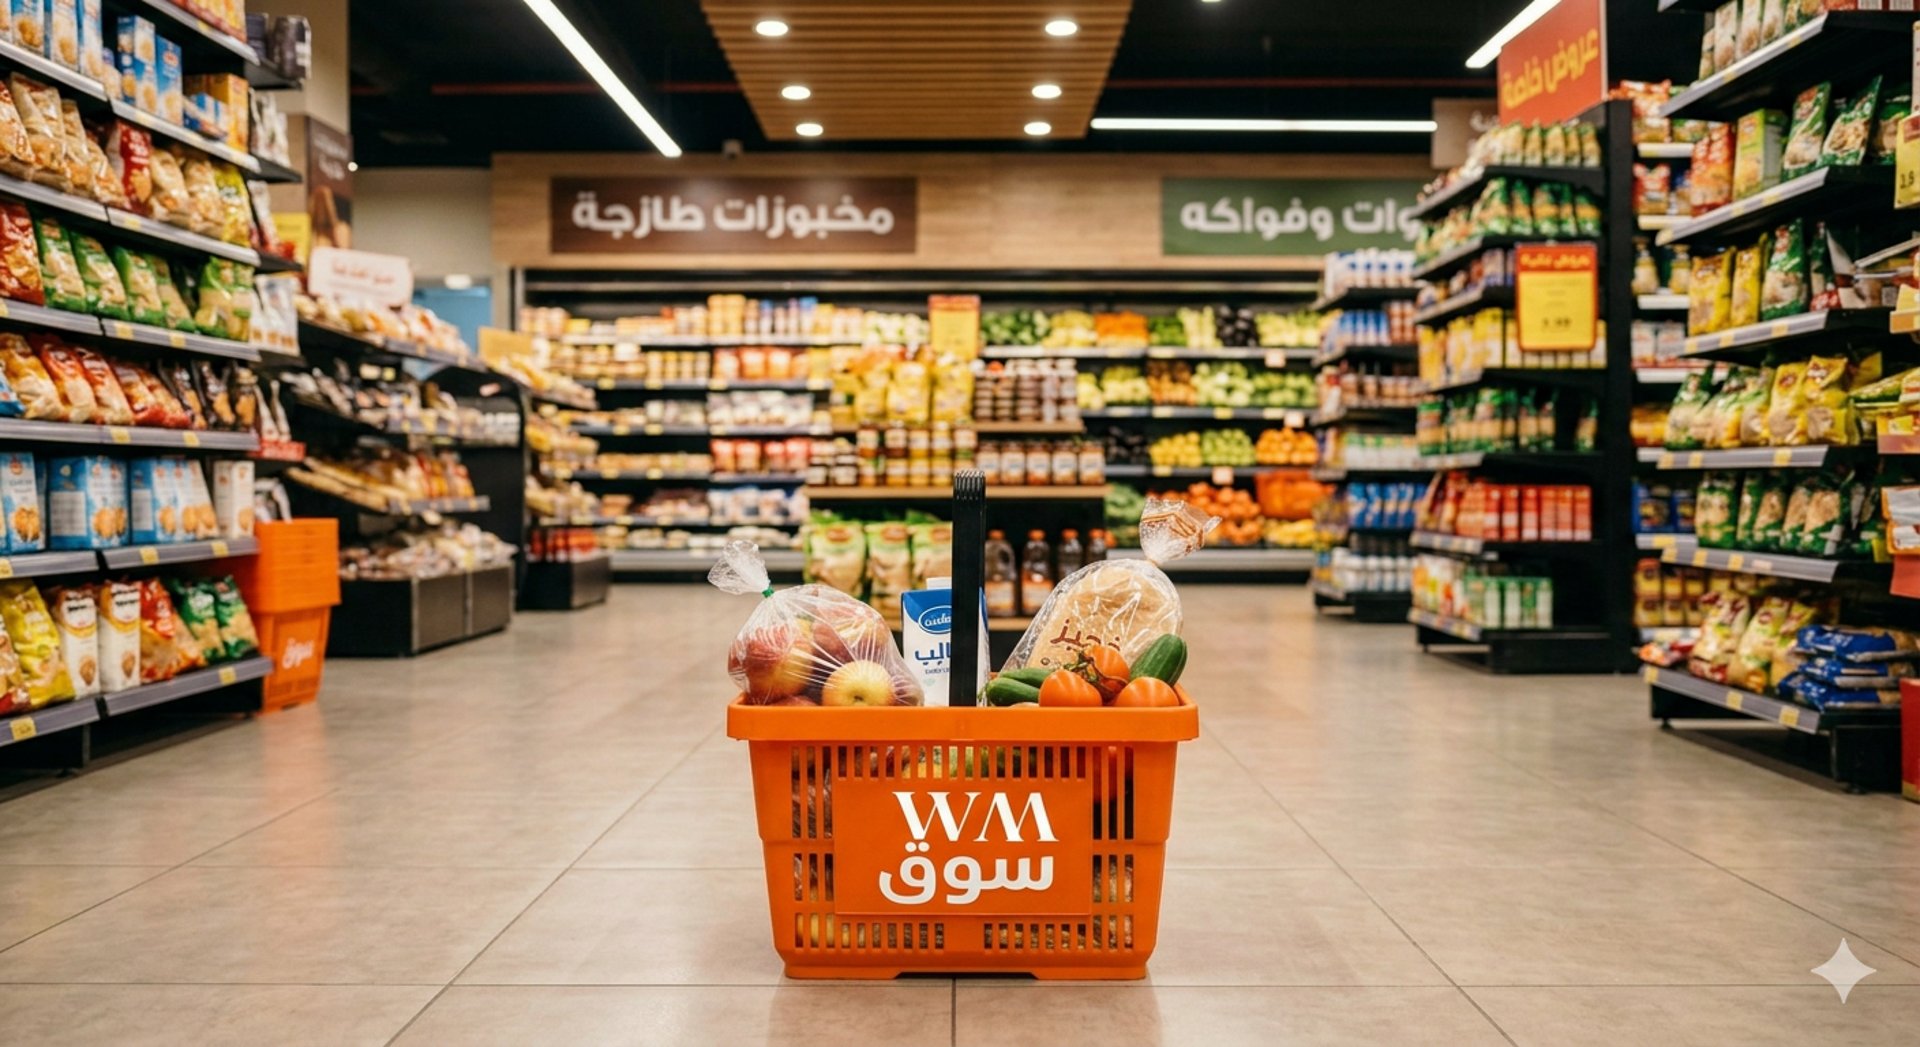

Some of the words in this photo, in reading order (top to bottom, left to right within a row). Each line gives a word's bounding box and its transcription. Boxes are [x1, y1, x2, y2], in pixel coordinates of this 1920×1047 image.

[1502, 55, 1543, 110] خاصة
[1544, 28, 1598, 94] عروض
[571, 190, 706, 240] طازجة
[713, 194, 895, 239] مخبوزات
[1180, 196, 1335, 241] وفواكه
[1341, 196, 1423, 242] وات
[892, 791, 1060, 842] WM
[878, 841, 1055, 905] سوق
